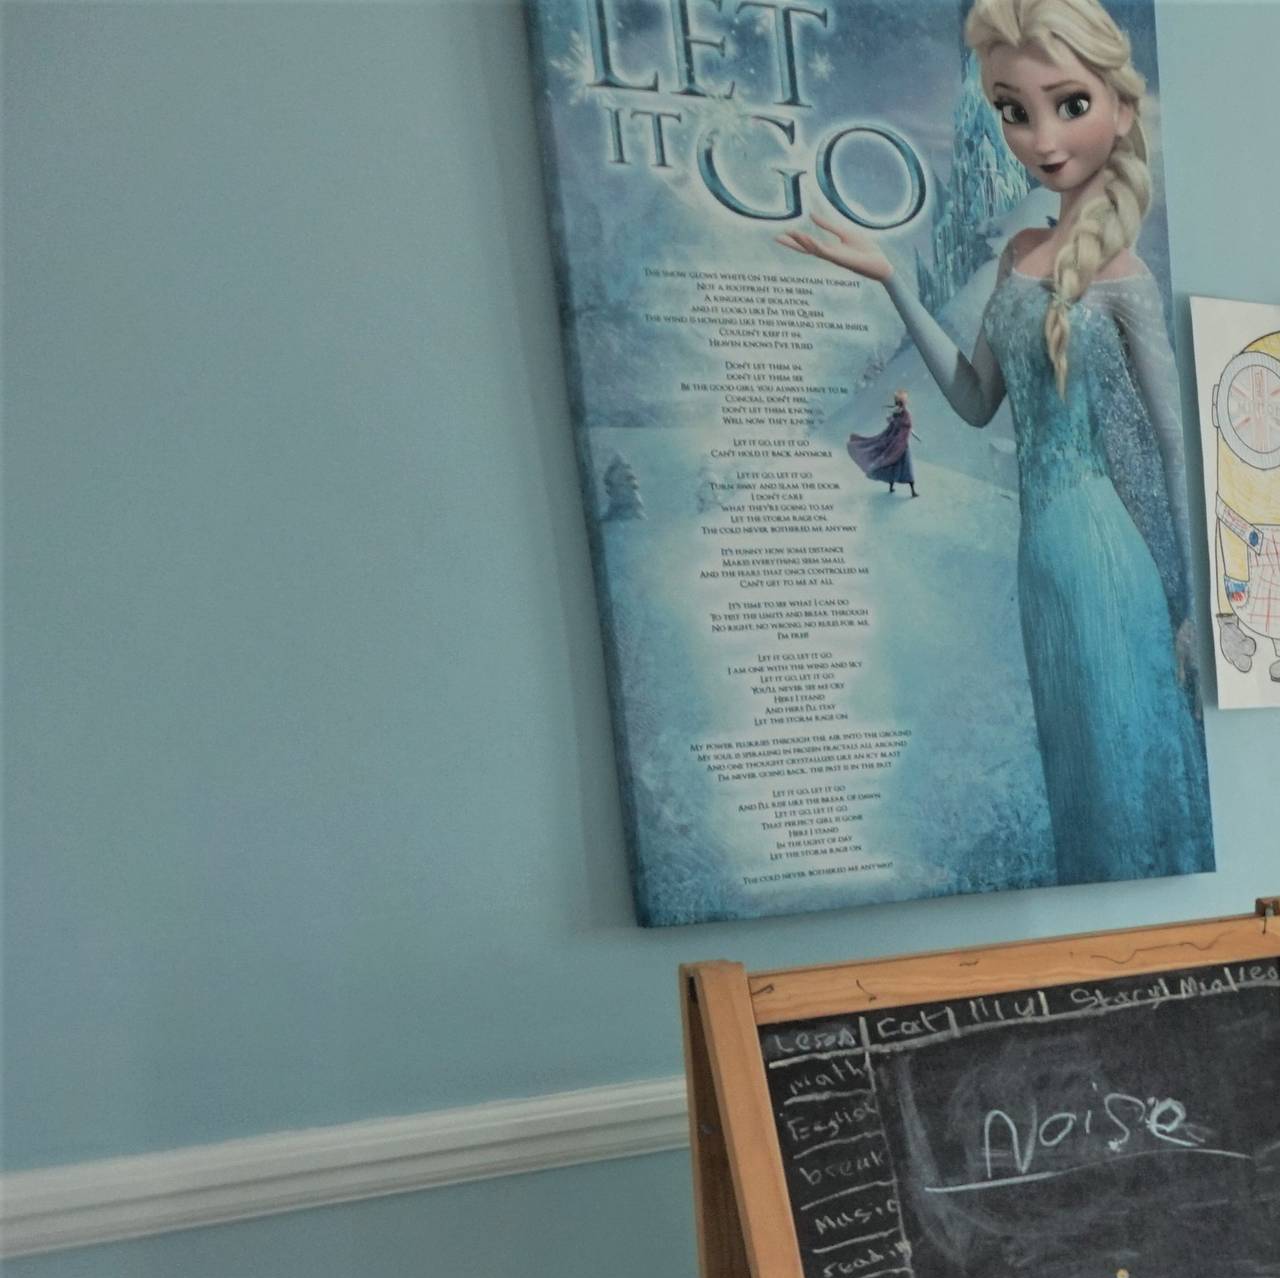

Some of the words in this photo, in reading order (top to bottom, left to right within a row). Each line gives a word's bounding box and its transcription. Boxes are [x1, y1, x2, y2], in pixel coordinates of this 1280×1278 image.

[586, 0, 829, 108] LET
[606, 106, 684, 168] IT
[696, 113, 931, 230] GO
